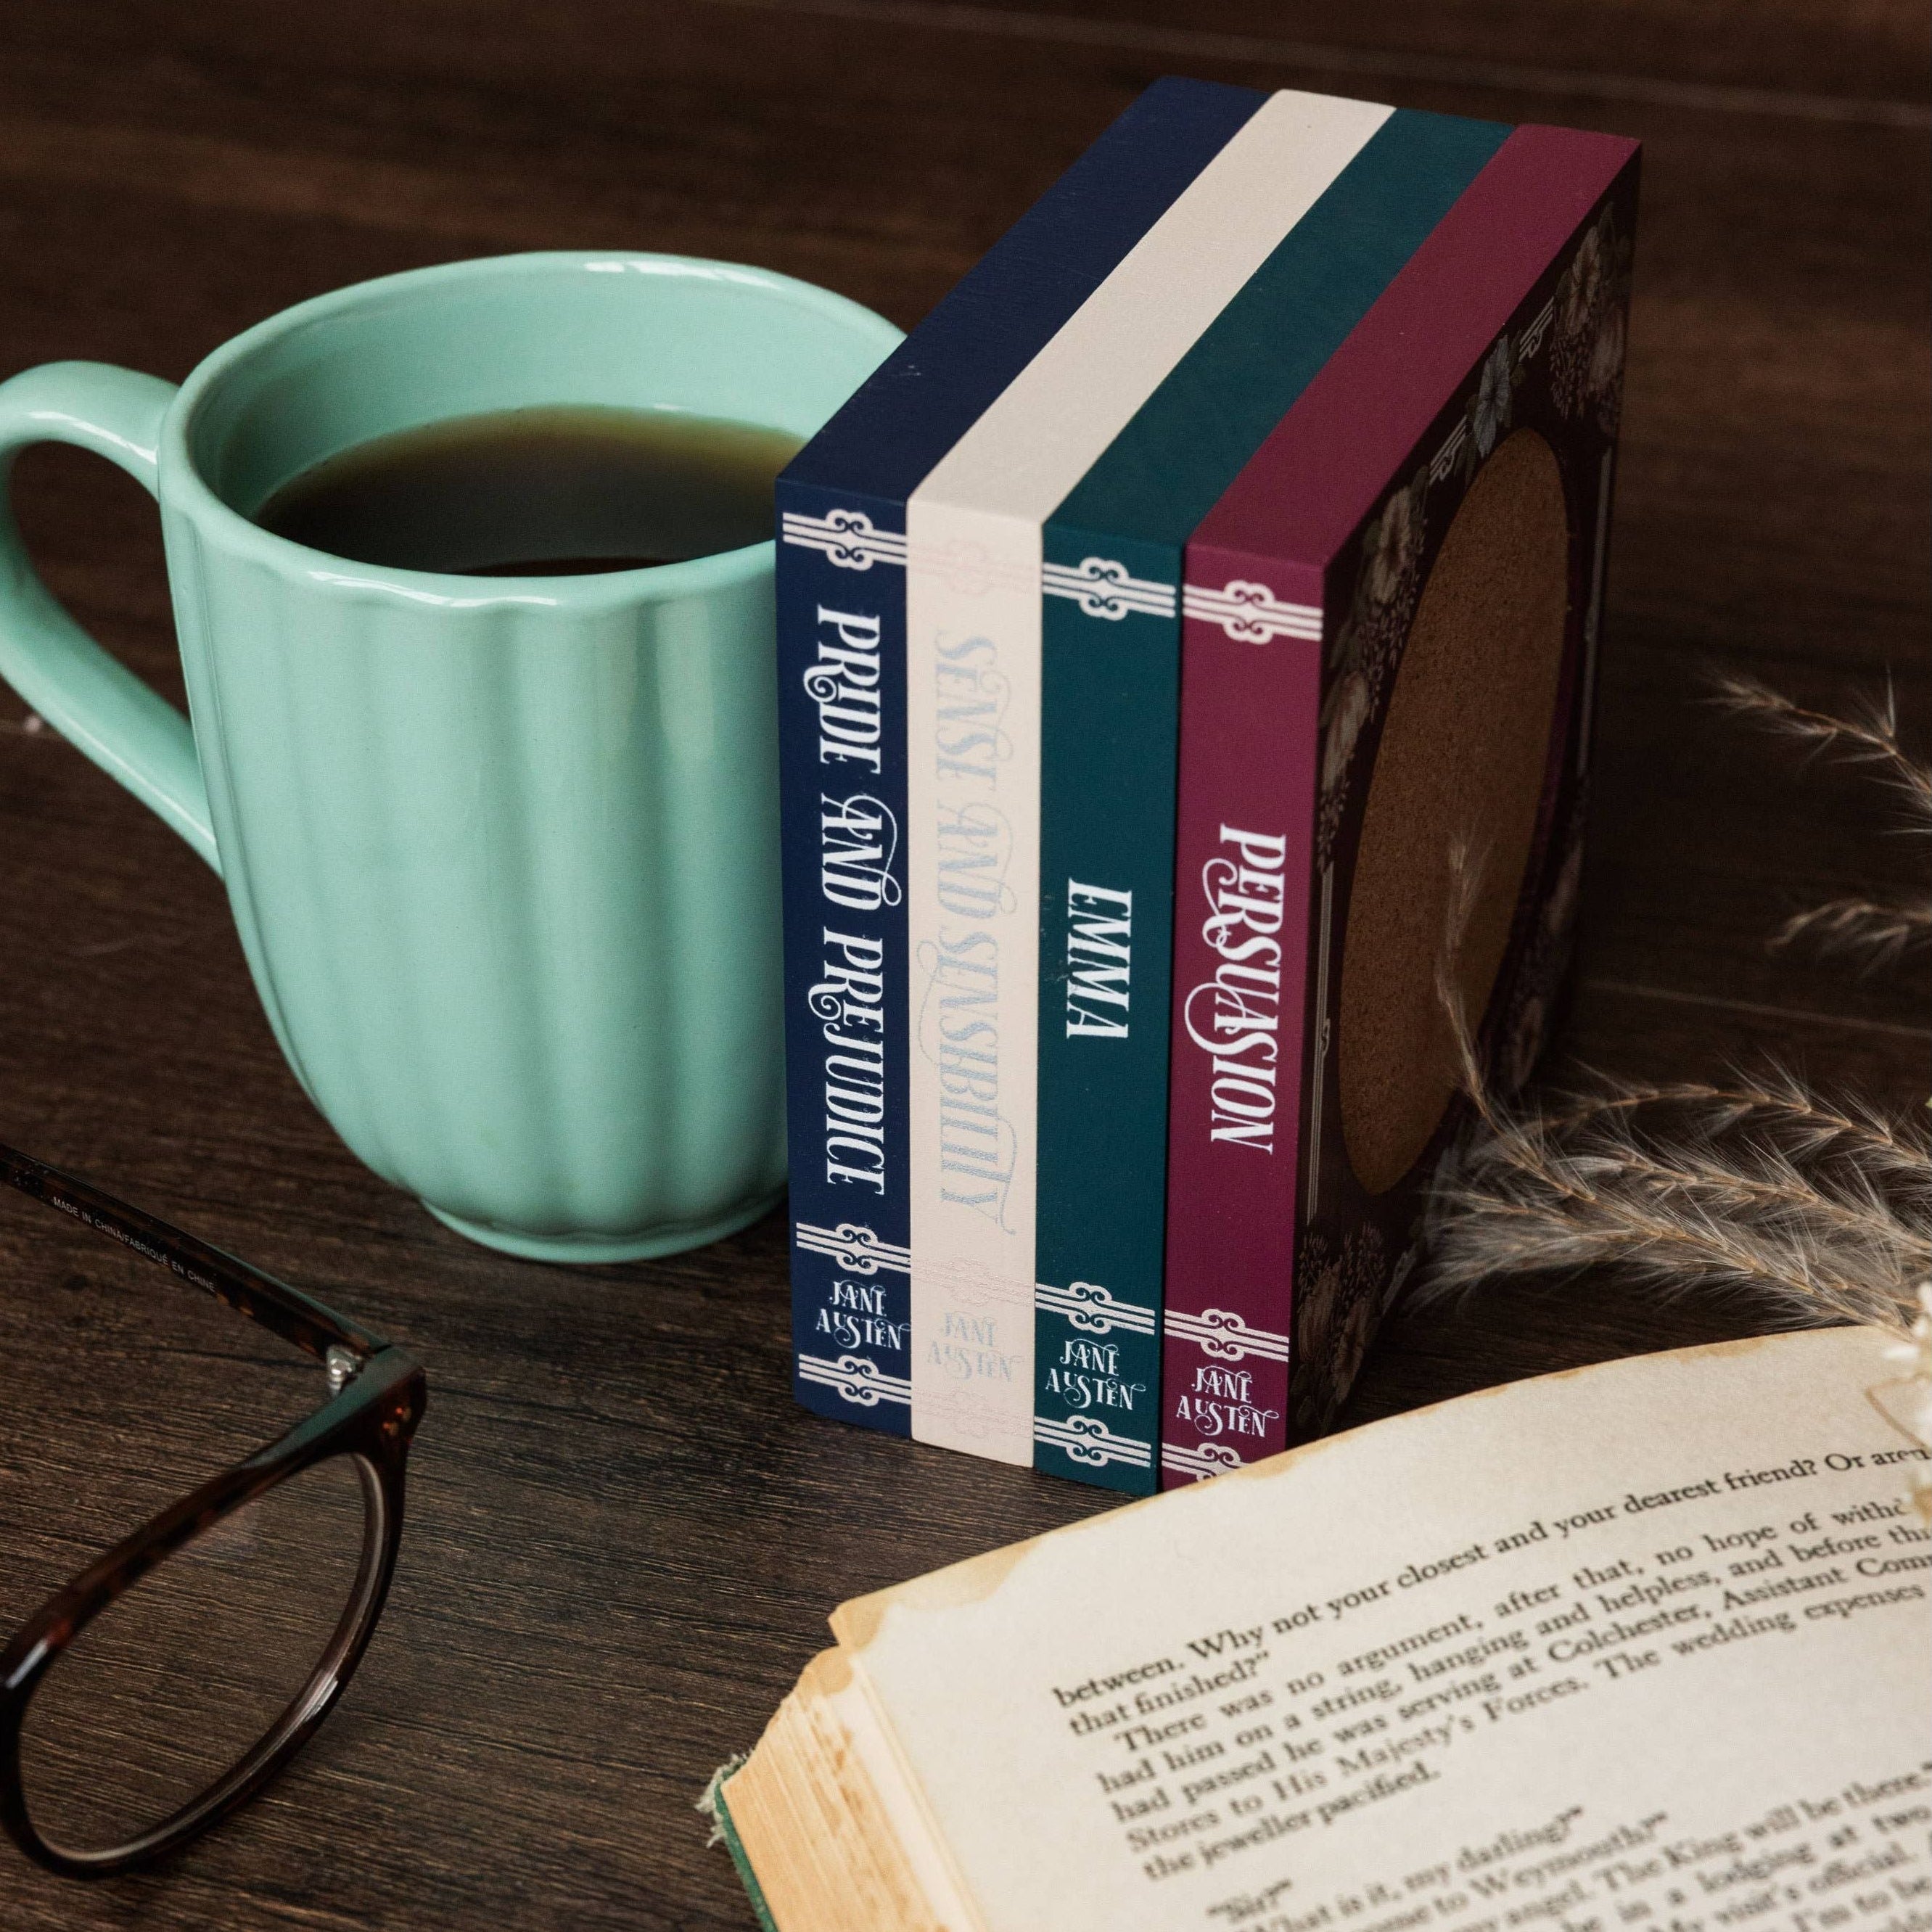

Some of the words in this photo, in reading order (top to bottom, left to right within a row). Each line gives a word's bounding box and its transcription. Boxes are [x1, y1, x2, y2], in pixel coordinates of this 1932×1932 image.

[803, 604, 881, 775] PRIDE
[934, 629, 1014, 791] SENSE
[821, 793, 902, 910] AND
[935, 798, 1017, 919] AND
[1066, 877, 1132, 1039] EMMA
[1184, 823, 1286, 1154] PERSUASION
[807, 925, 885, 1196] PREJUDICE
[917, 924, 1017, 1234] SENSIBILITY
[53, 1196, 78, 1217] MADE
[81, 1211, 91, 1224] IN
[172, 1262, 184, 1275] EN
[187, 1270, 215, 1292] CHINE
[829, 1279, 887, 1317] JANE
[815, 1309, 910, 1350] AUSTEN
[927, 1341, 1024, 1382] AUSTEN
[940, 1310, 998, 1347] JANE
[1059, 1338, 1119, 1376] JANE
[1191, 1365, 1252, 1403] JANE
[1045, 1370, 1146, 1410] AUSTEN
[1176, 1396, 1279, 1437] AUSTEN
[1053, 1657, 1184, 1708] between.
[1187, 1626, 1265, 1661] Why
[1273, 1603, 1320, 1636] not
[1327, 1579, 1390, 1619] your
[1397, 1543, 1487, 1590] closest
[1494, 1521, 1548, 1555] and
[1555, 1503, 1617, 1539] your
[1623, 1478, 1722, 1515] dearest
[1723, 1458, 1818, 1492] friend?
[1824, 1452, 1866, 1472] Or
[1114, 1711, 1207, 1754] There
[1218, 1690, 1275, 1719] was
[1287, 1672, 1325, 1697] no
[1336, 1612, 1484, 1677] argument,
[1494, 1583, 1563, 1619] after
[1572, 1558, 1645, 1591] that,
[1656, 1545, 1695, 1567] no
[1703, 1525, 1778, 1557] hope
[1789, 1513, 1820, 1535] of
[1069, 1703, 1132, 1737] that
[1096, 1757, 1157, 1794] had
[1163, 1739, 1226, 1773] him
[1236, 1723, 1275, 1748] on
[1284, 1712, 1301, 1731] a
[1311, 1674, 1404, 1720] string,
[1409, 1629, 1528, 1684] hanging
[1534, 1603, 1591, 1637] and
[1598, 1569, 1722, 1616] helpless,
[1728, 1550, 1783, 1578] and
[1791, 1532, 1882, 1564] before
[1111, 1788, 1172, 1824] had
[1180, 1751, 1278, 1805] passed
[1283, 1738, 1325, 1764] he
[1333, 1714, 1389, 1744] was
[1397, 1671, 1503, 1719] serving
[1509, 1657, 1539, 1680] at
[1547, 1603, 1714, 1664] Colchester,
[1720, 1567, 1849, 1613] Assistant
[1127, 1810, 1222, 1854] Stores
[1230, 1793, 1264, 1817] to
[1271, 1772, 1328, 1801] His
[1481, 1677, 1590, 1722] Forces.
[1592, 1647, 1660, 1682] The
[1672, 1608, 1797, 1658] wedding
[1802, 1583, 1925, 1624] expenses
[1143, 1853, 1196, 1880] the
[1199, 1812, 1312, 1867] jeweller
[1317, 1759, 1442, 1828] pacified.
[1592, 1859, 1663, 1891] The
[1664, 1832, 1743, 1867] King
[1744, 1804, 1801, 1839] will
[1797, 1798, 1841, 1822] be
